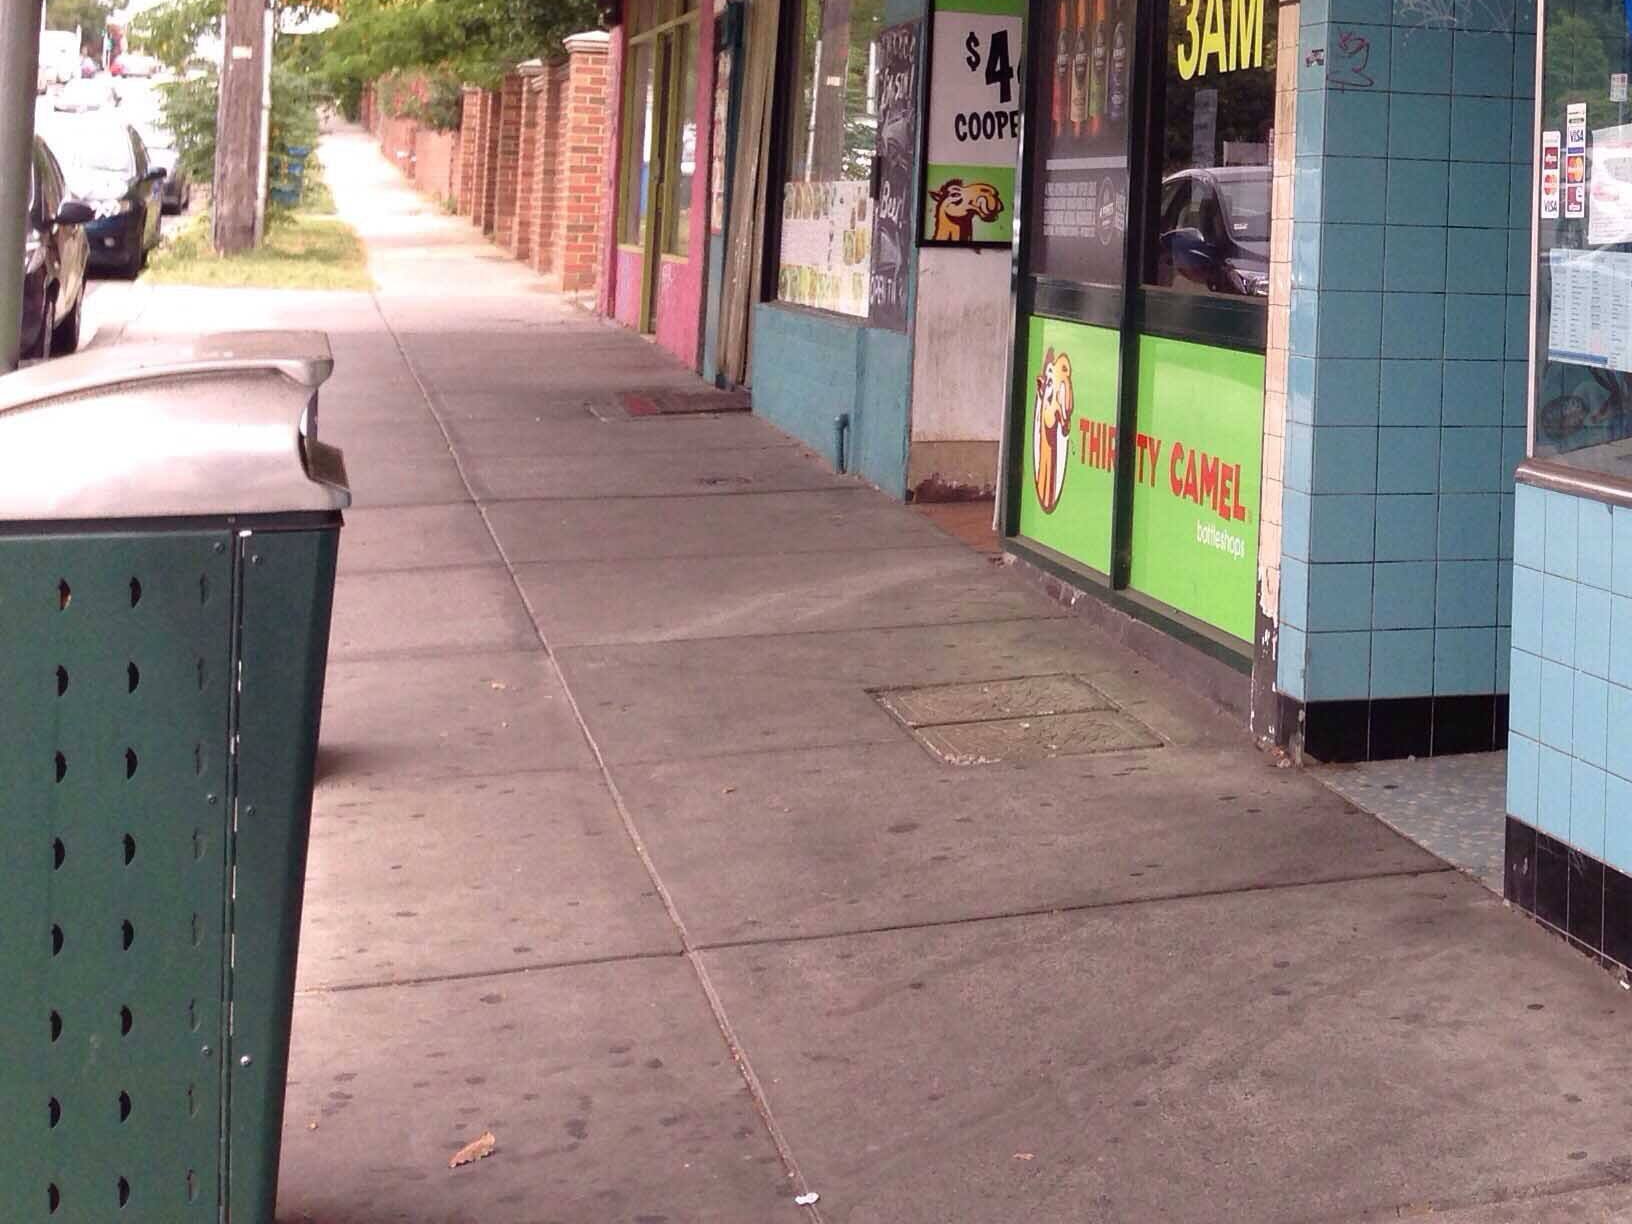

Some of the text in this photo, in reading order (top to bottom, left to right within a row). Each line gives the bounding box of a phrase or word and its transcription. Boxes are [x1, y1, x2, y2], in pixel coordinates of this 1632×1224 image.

[1569, 130, 1584, 143] VISA
[1079, 417, 1246, 523] THIRTY CAMEL
[1196, 519, 1245, 560] bottleshops
